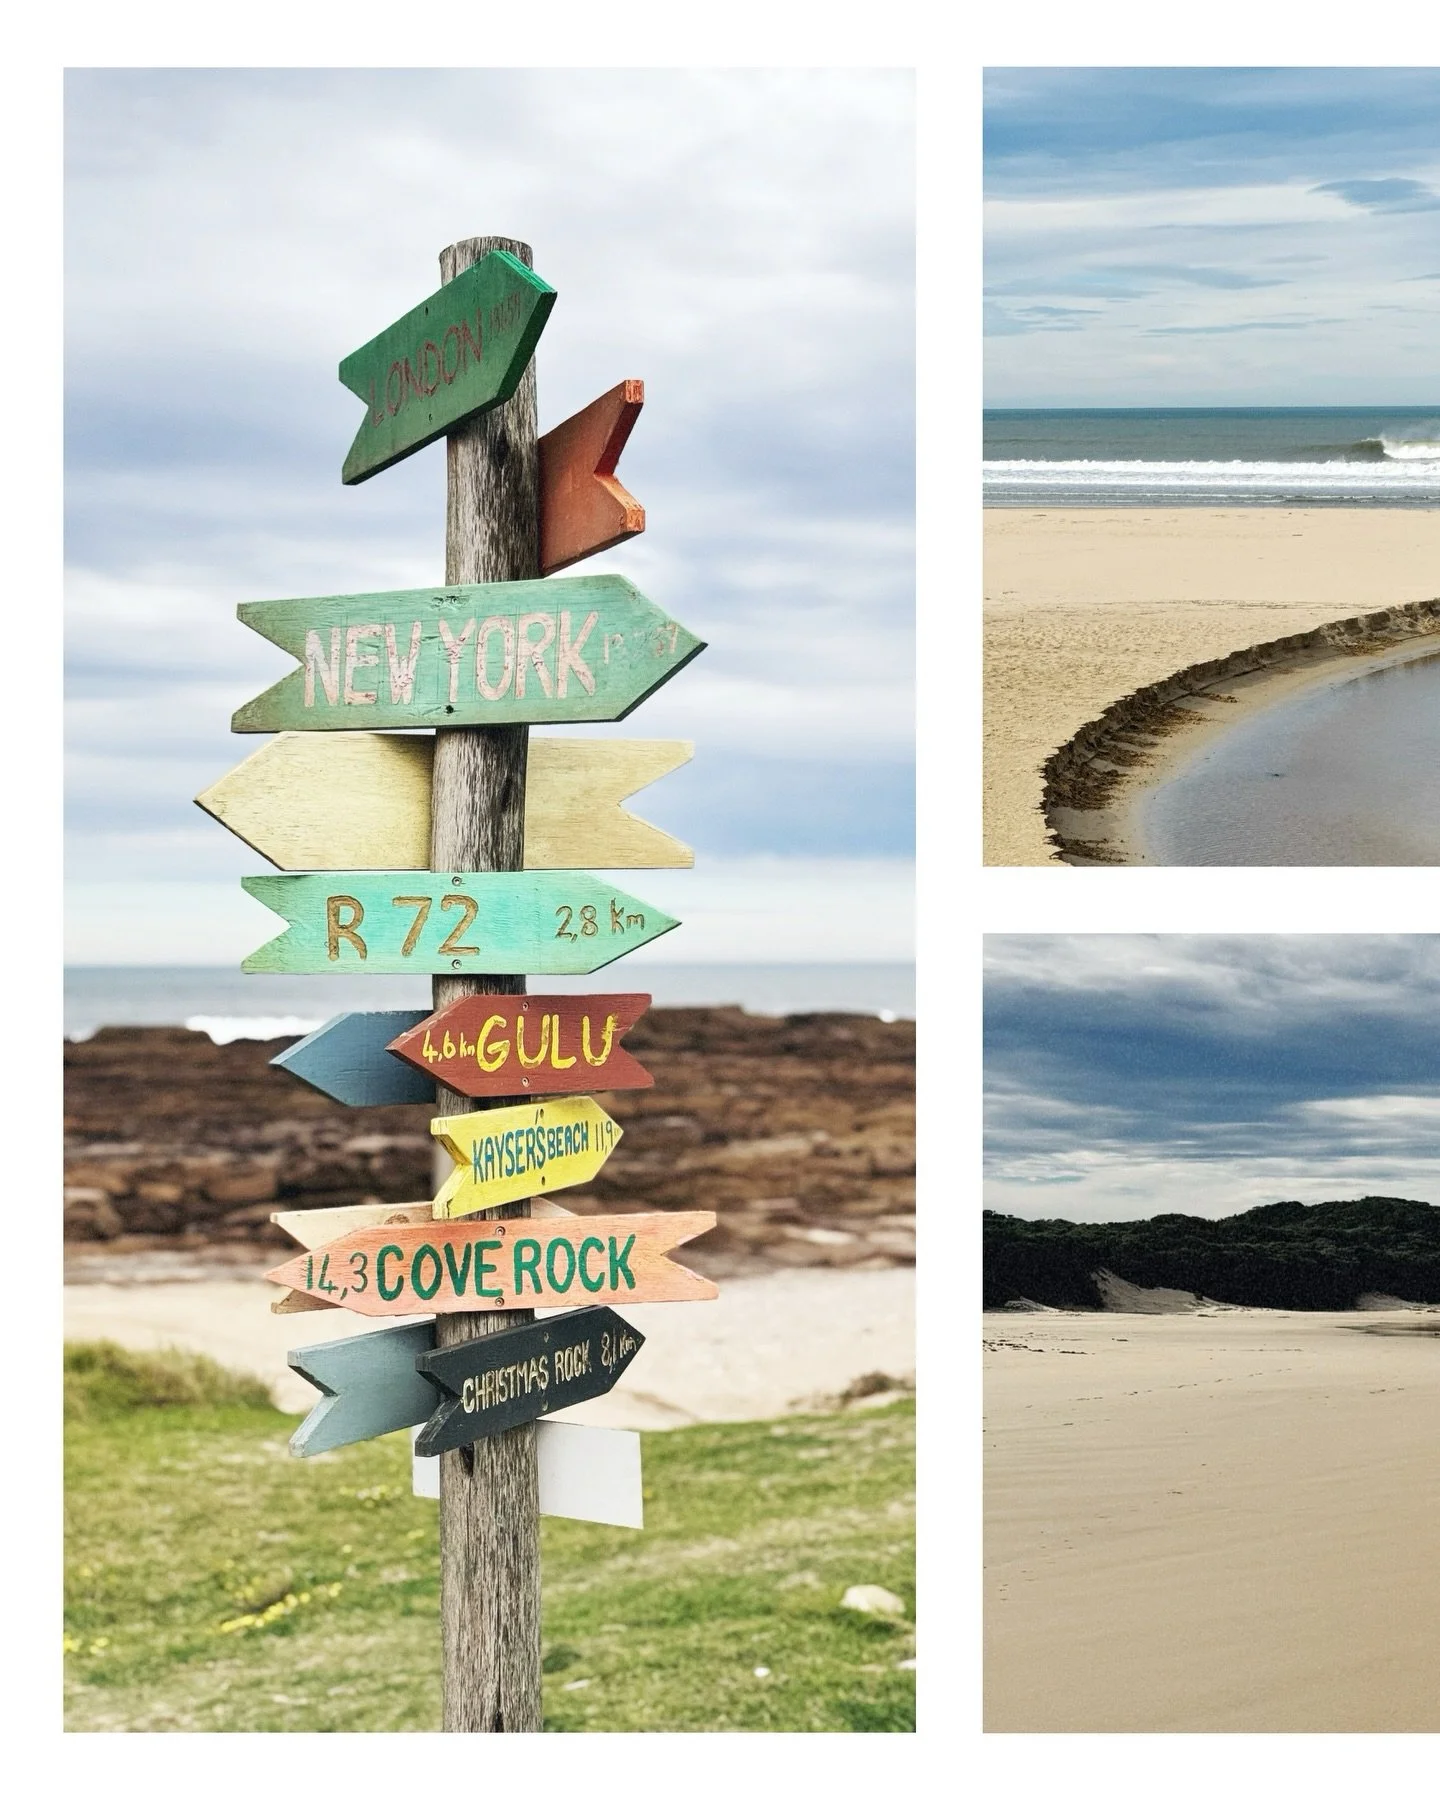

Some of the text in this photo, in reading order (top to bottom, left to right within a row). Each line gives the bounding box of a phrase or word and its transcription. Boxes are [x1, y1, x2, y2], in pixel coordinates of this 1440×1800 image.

[370, 307, 483, 428] LONDON
[304, 621, 421, 707] NEW
[439, 610, 598, 703] YORK
[327, 895, 367, 961] R
[392, 894, 481, 957] 72
[555, 905, 599, 943] 2,8
[422, 1030, 457, 1063] 4,6
[476, 1014, 618, 1072] GULU
[546, 1120, 589, 1161] BEACH
[595, 1120, 613, 1154] 11,9
[303, 1233, 637, 1300] 14,3 COVE ROCK
[462, 1355, 549, 1414] CHRISTMAS
[554, 1339, 593, 1385] ROCK
